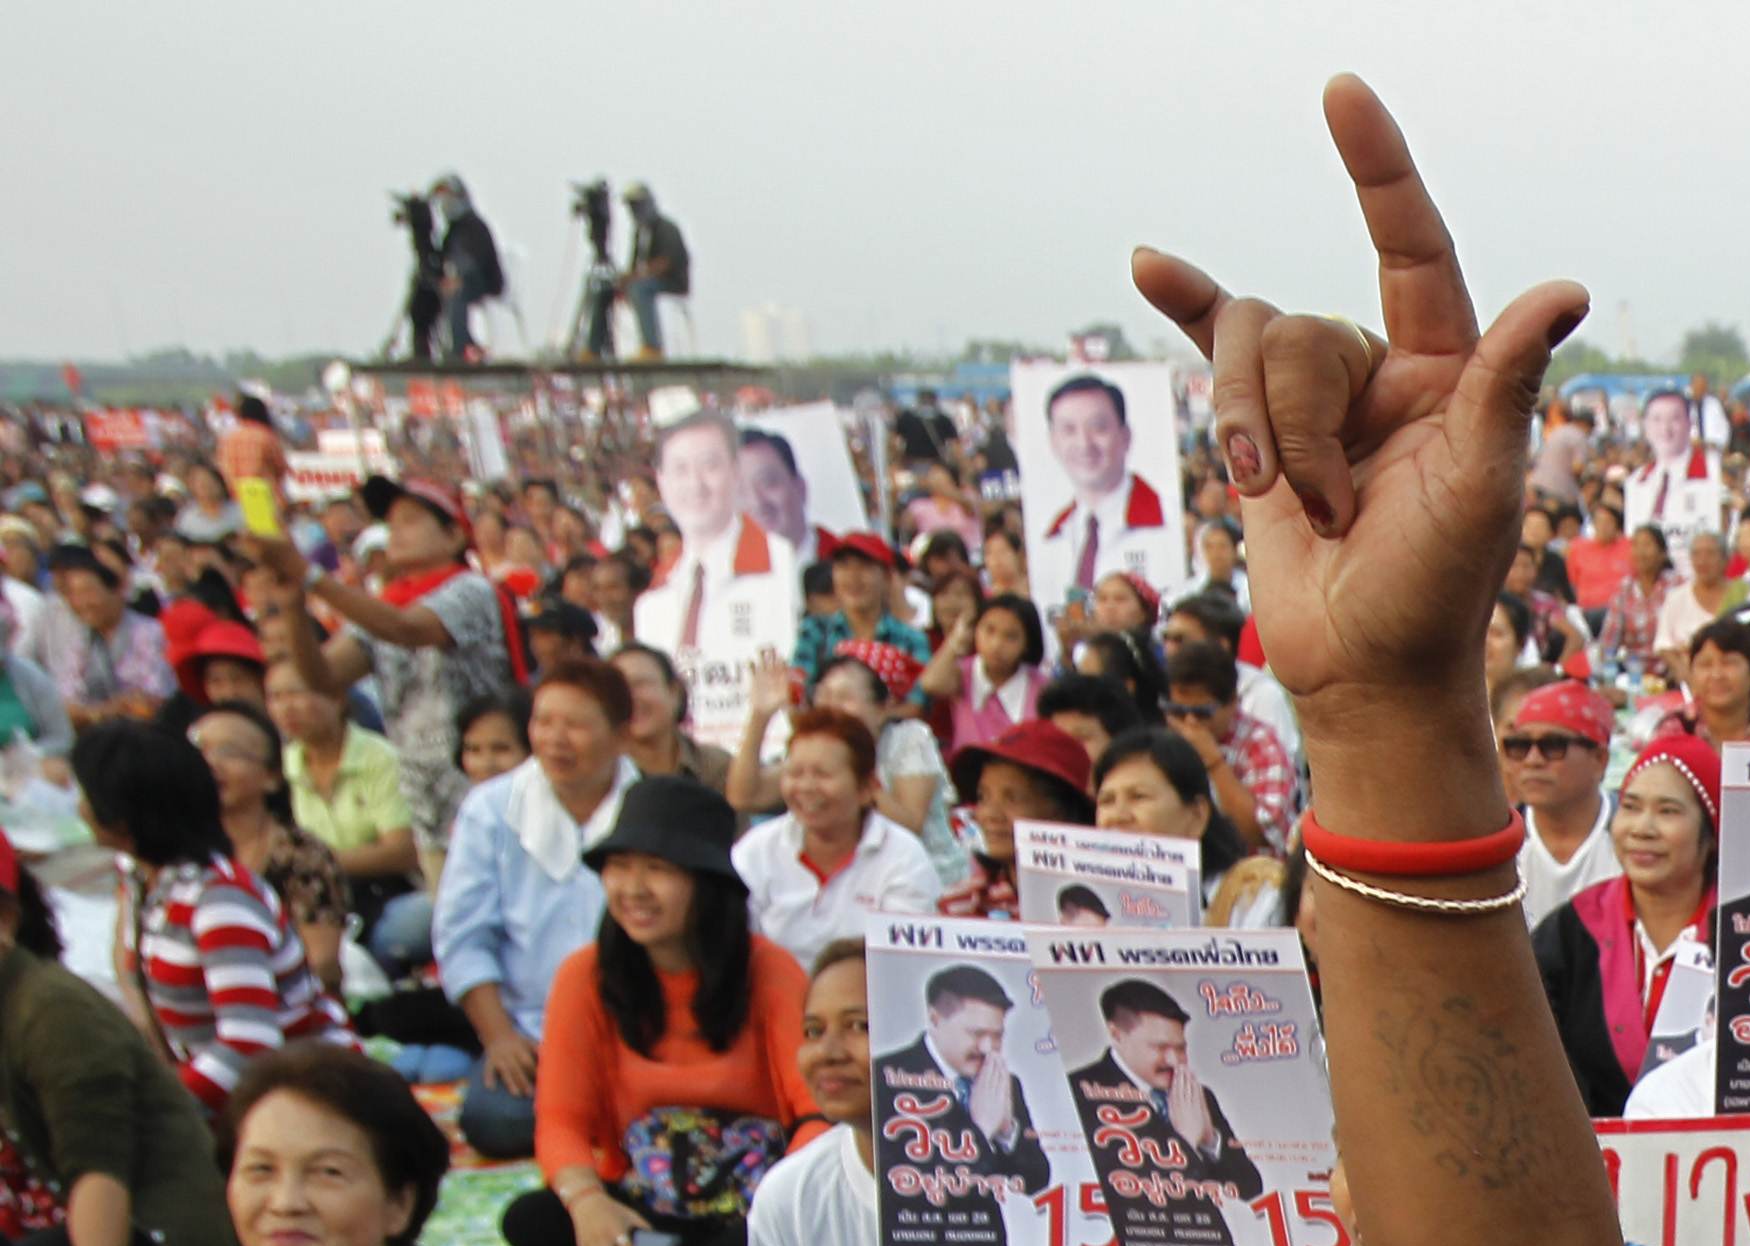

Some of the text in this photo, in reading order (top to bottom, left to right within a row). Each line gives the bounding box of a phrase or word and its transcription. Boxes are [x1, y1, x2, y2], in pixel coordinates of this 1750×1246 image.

[1032, 850, 1067, 868] พท
[888, 926, 943, 949] พท
[1049, 937, 1279, 966] พท พรรคเพื่อไทย
[884, 1094, 977, 1163] วัน
[1095, 1105, 1188, 1169] วัน
[888, 1164, 1026, 1207] อยู่บำรุง
[1108, 1170, 1240, 1209] อยู่บำรุง
